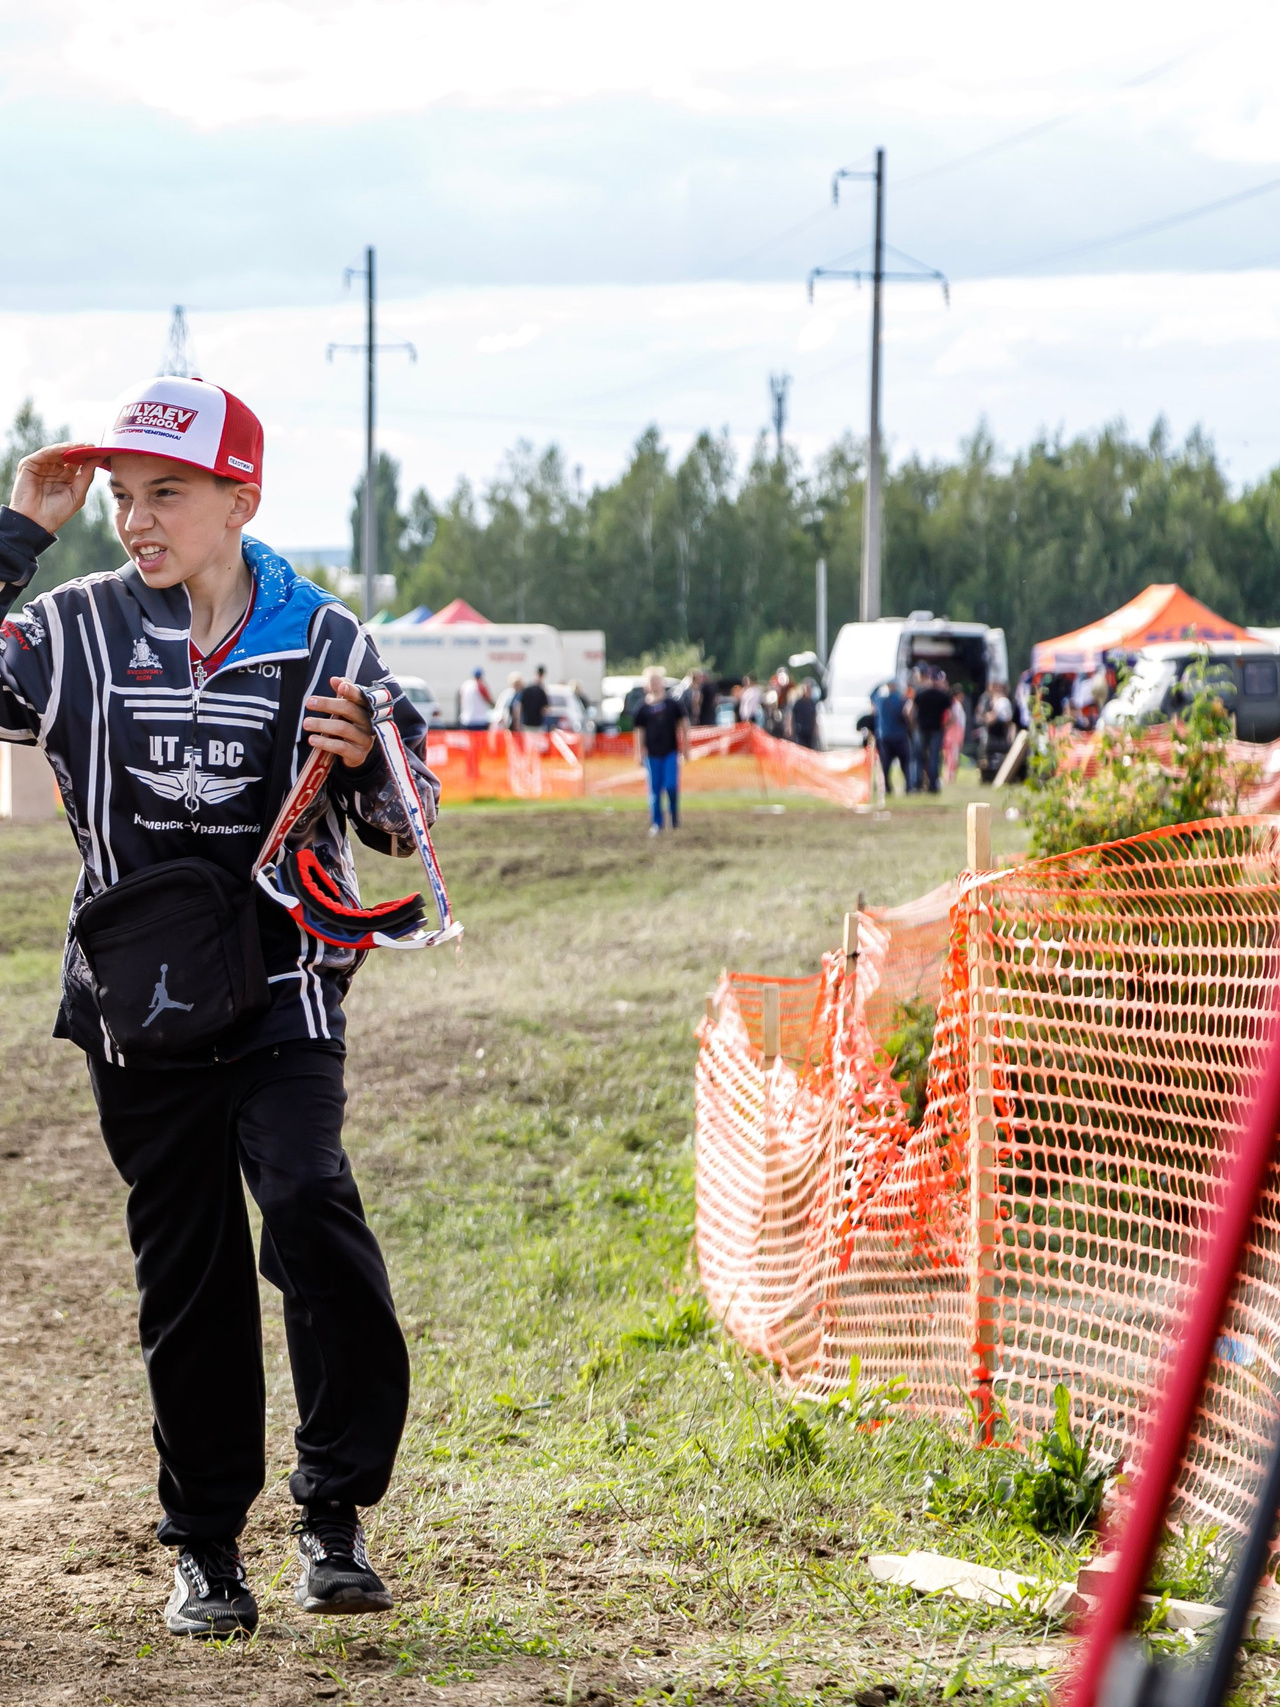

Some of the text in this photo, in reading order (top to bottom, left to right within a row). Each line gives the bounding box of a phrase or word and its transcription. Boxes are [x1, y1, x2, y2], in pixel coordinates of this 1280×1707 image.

[120, 403, 193, 424] MILYAEV
[135, 416, 179, 430] SCHOOL
[149, 735, 244, 768] ЦТ ВС
